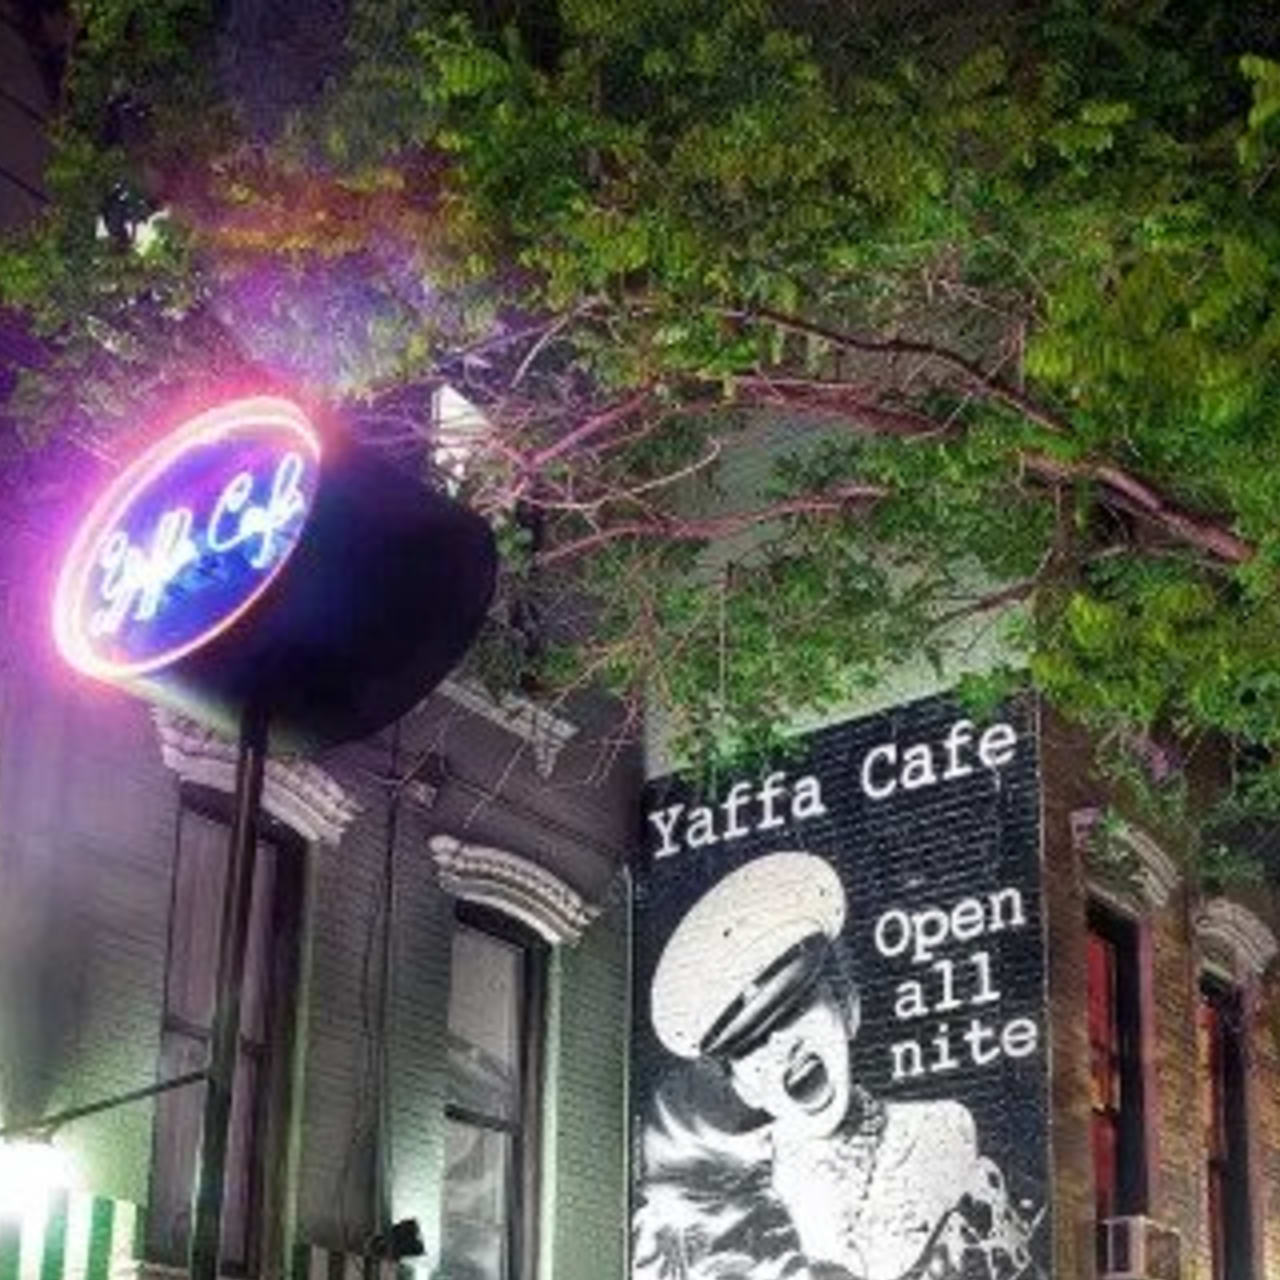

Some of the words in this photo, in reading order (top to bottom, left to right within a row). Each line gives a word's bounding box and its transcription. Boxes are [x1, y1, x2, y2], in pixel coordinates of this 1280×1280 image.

[648, 770, 827, 860] Yaffa
[861, 719, 1018, 798] Cafe
[874, 886, 1027, 964] Open
[894, 952, 1002, 1020] all
[890, 1016, 1038, 1080] nite
